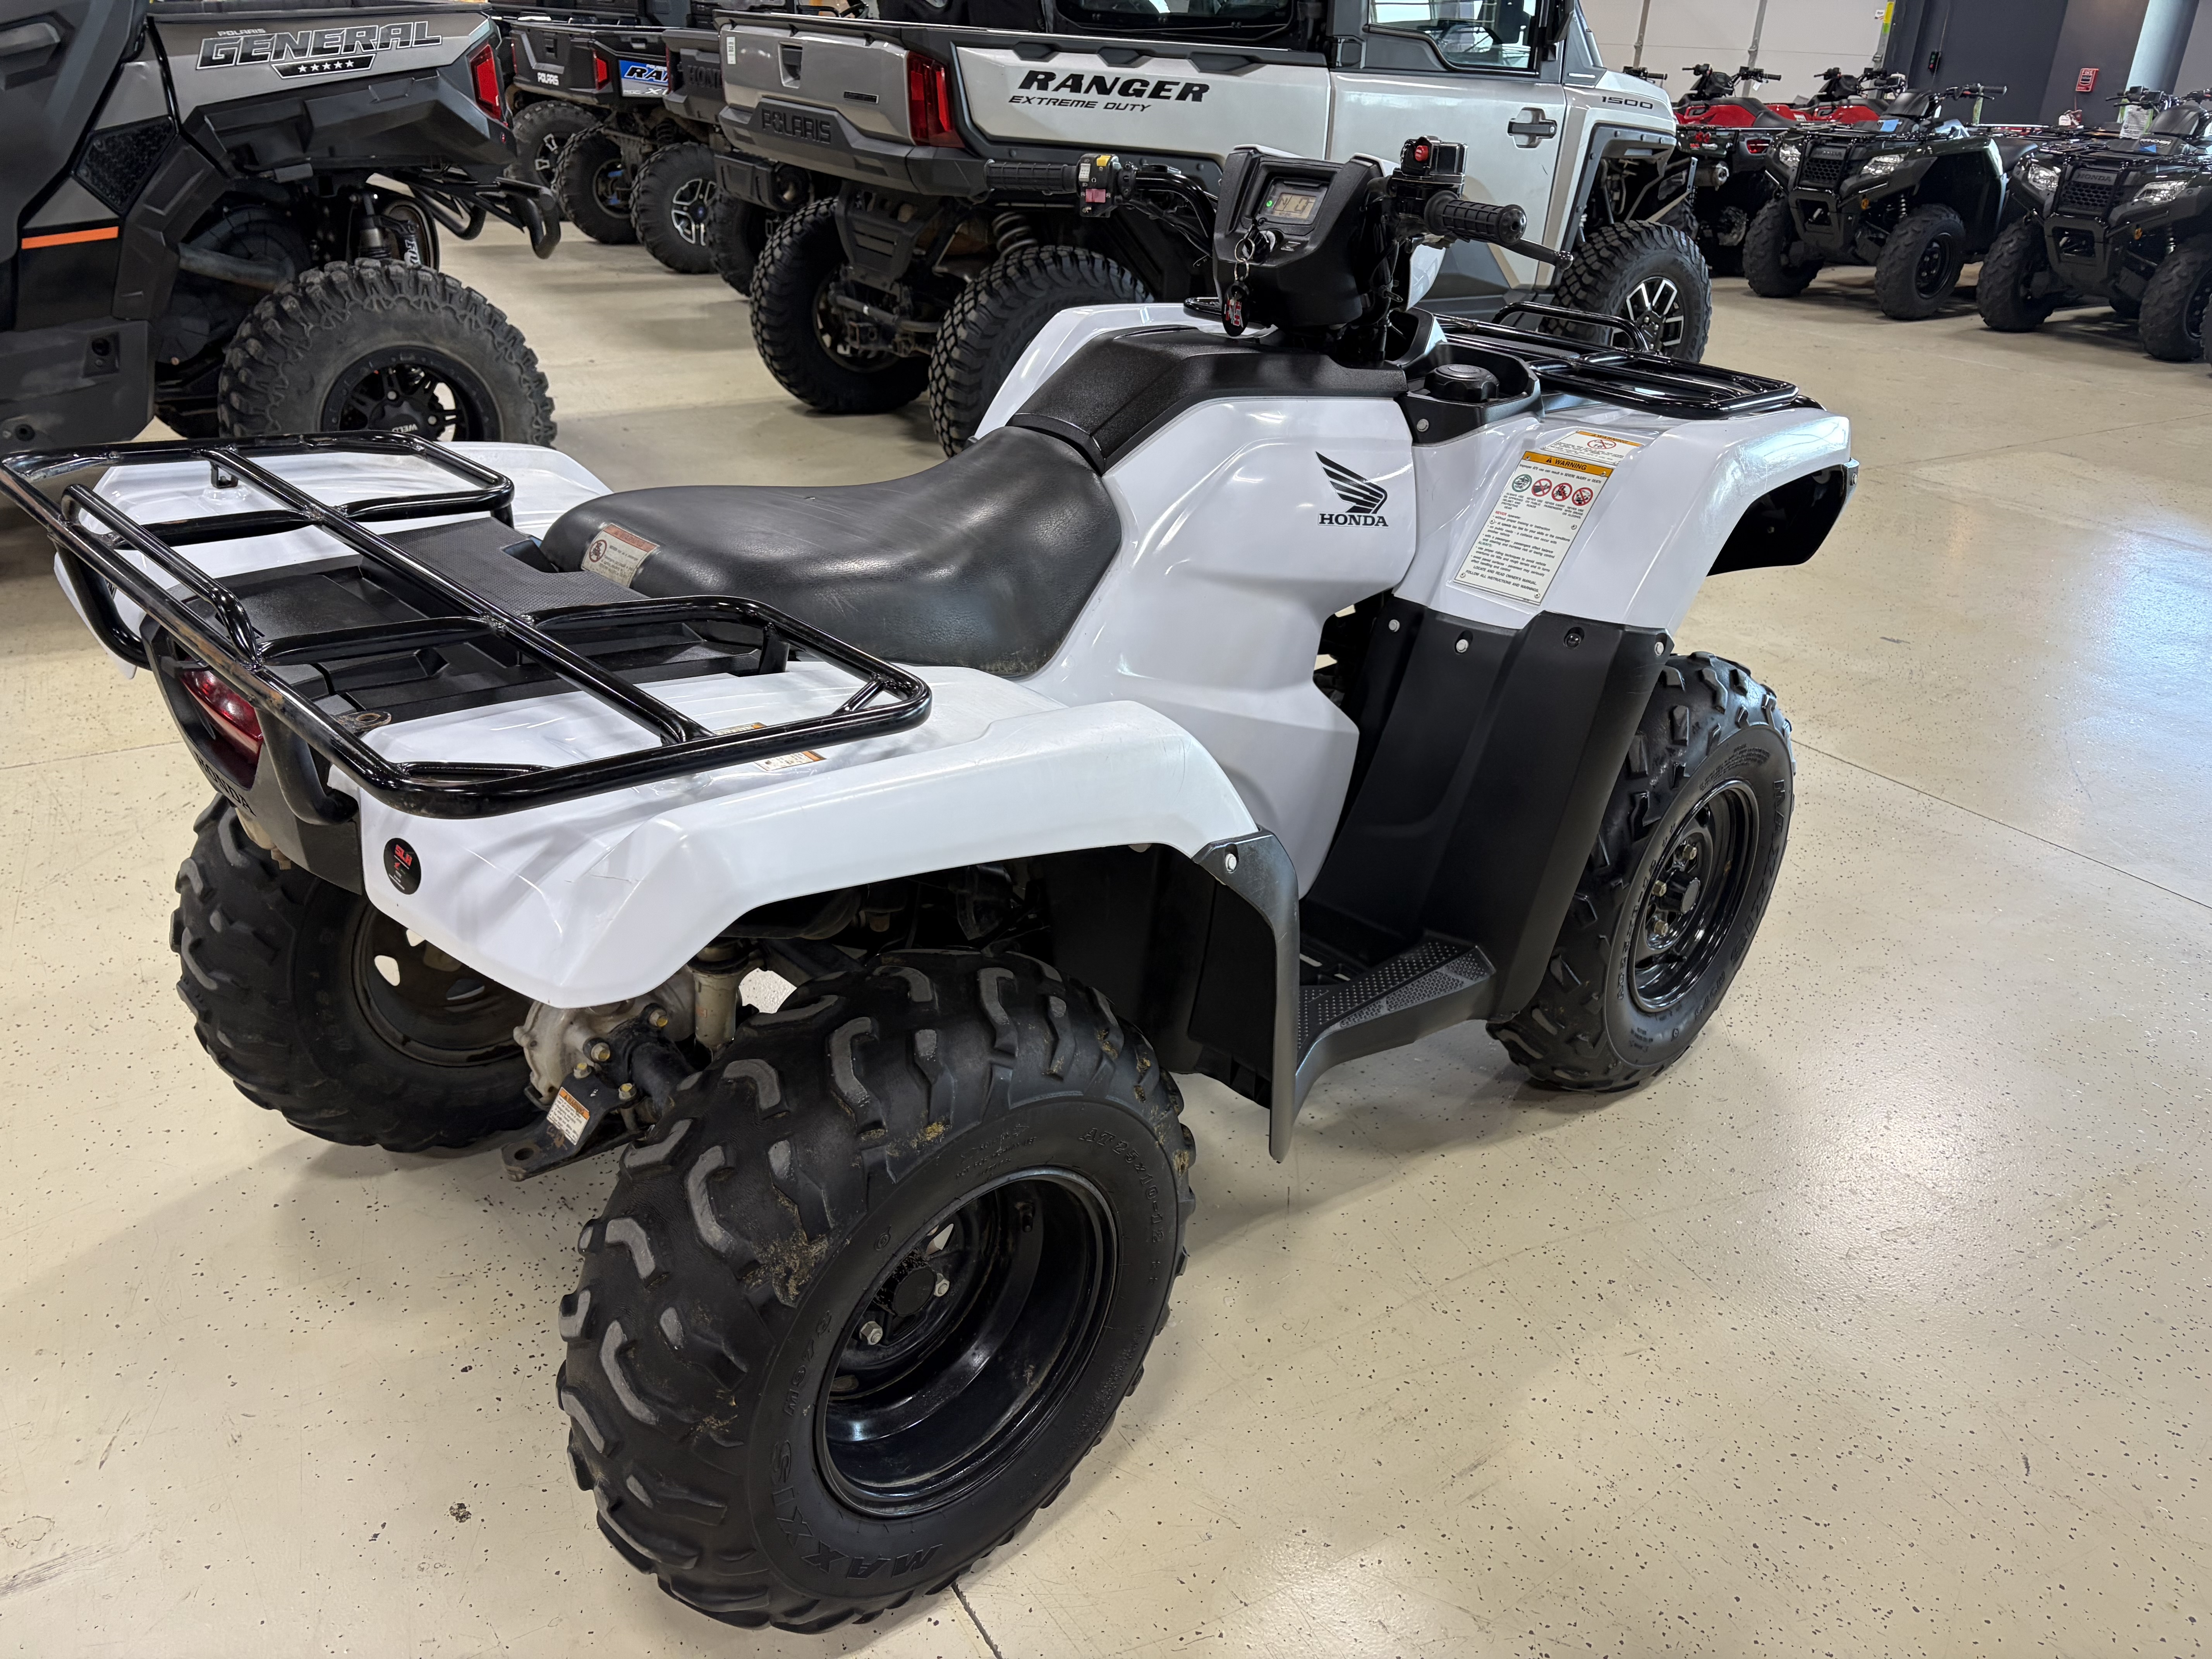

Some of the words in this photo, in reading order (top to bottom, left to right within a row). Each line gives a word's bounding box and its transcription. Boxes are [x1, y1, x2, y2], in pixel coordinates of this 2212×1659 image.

[216, 28, 266, 36] POLARIS
[196, 21, 442, 70] GENERAL
[1018, 70, 1210, 103] RANGER
[1008, 95, 1098, 109] EXTREME
[1103, 102, 1152, 112] DUTY
[1602, 96, 1653, 109] 1500
[762, 109, 831, 144] POLARIS
[2077, 173, 2111, 182] HONDA
[1553, 459, 1588, 471] WARNING
[1319, 514, 1389, 527] HONDA
[194, 750, 257, 817] HONDA
[772, 1439, 943, 1580] MAXXIS
